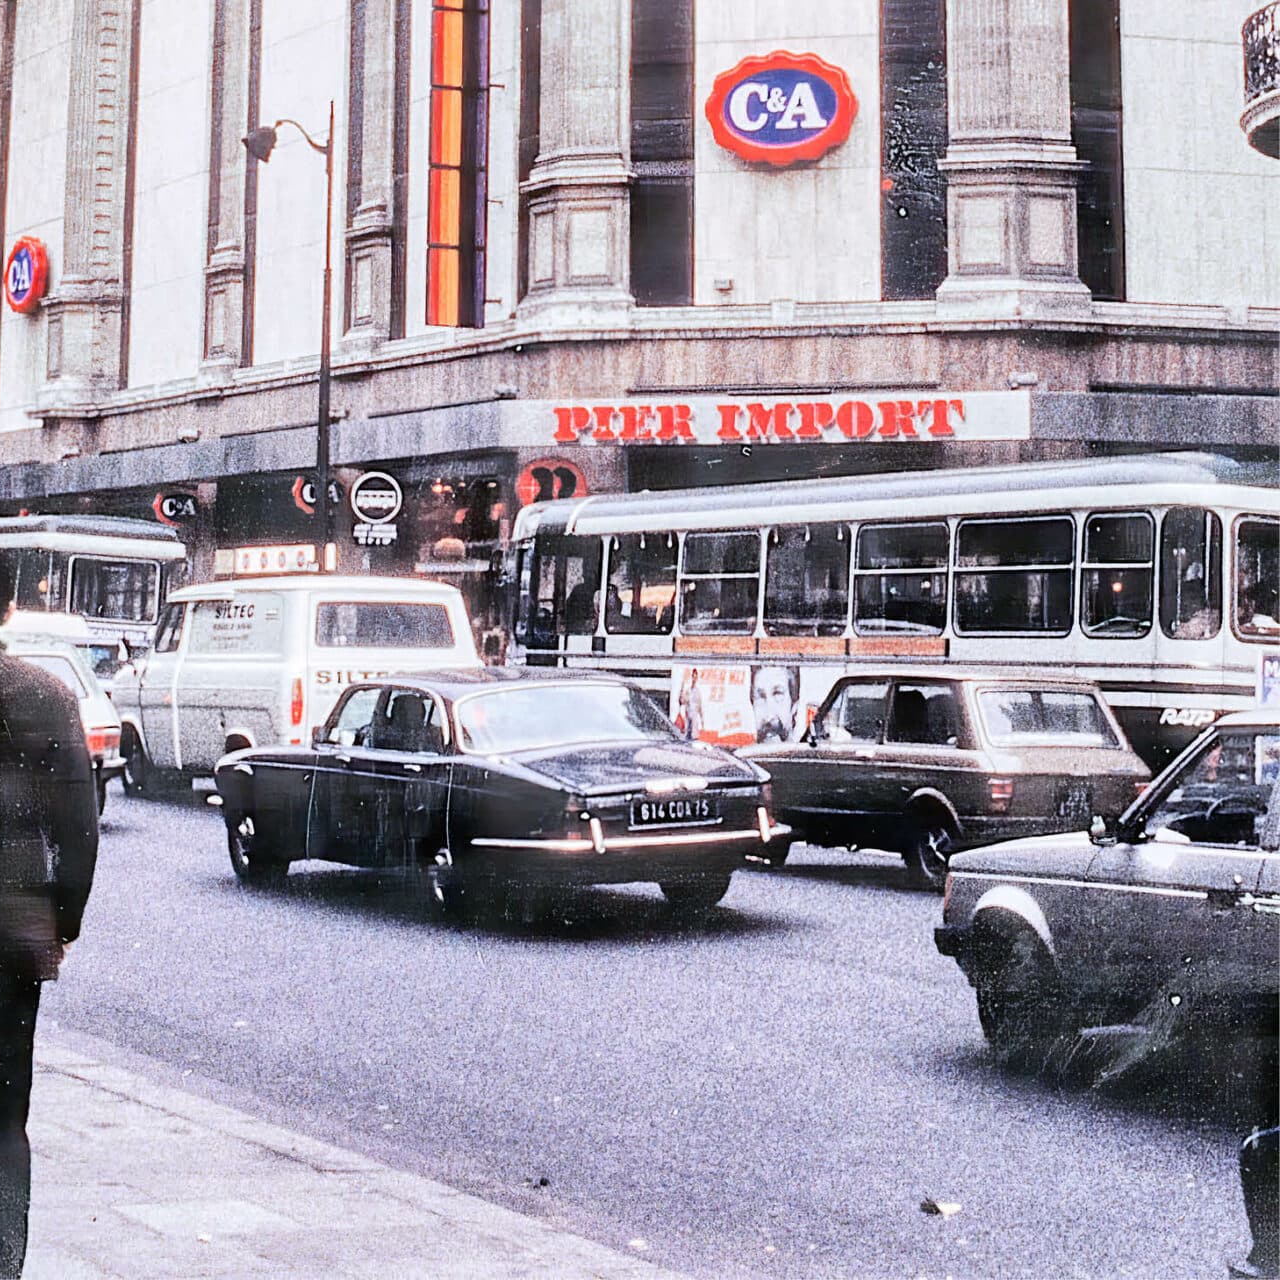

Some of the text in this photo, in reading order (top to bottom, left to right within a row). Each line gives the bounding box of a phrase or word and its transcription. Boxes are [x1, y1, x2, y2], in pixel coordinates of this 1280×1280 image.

[729, 81, 828, 132] C&A
[552, 398, 966, 442] PIER IMPORT
[301, 483, 340, 504] CA
[161, 498, 197, 517] C&A
[214, 603, 255, 619] SILTEC
[315, 669, 405, 685] SILT
